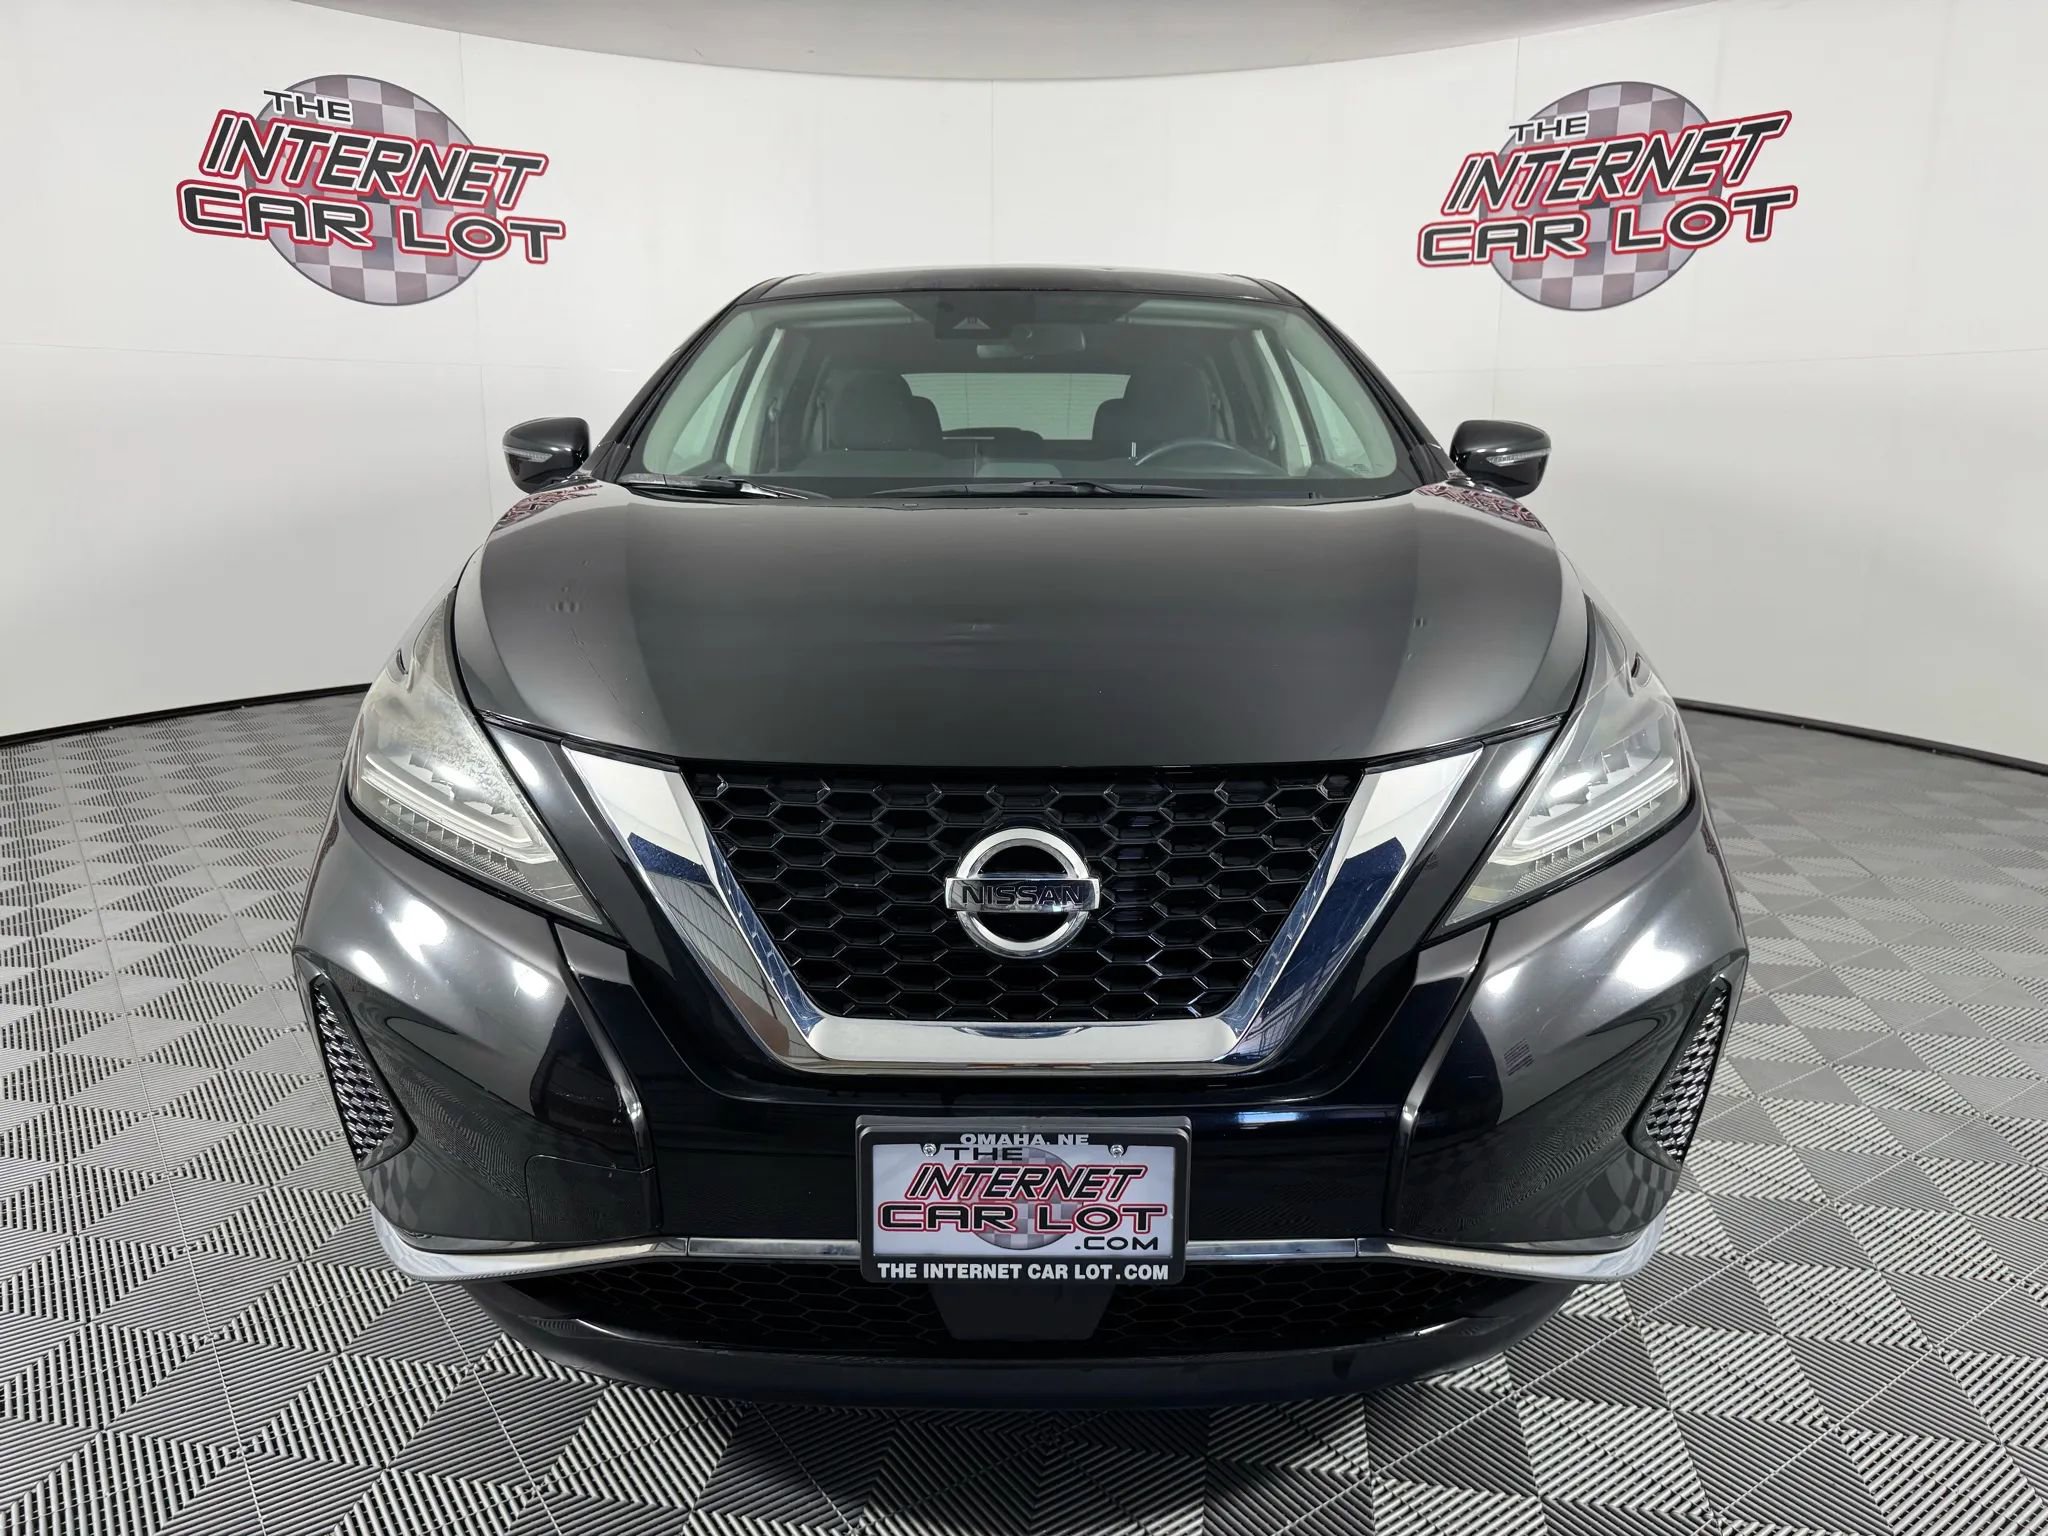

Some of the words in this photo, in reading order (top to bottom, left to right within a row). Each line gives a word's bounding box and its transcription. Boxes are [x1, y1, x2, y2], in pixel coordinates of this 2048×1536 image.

[263, 89, 353, 122] THE
[1508, 114, 1589, 143] THE
[202, 112, 546, 207] INTERNET
[1443, 112, 1790, 212] INTERNET
[179, 182, 372, 248] CAR
[399, 207, 564, 262] LOT
[1419, 214, 1589, 265] CAR
[1614, 188, 1796, 253] LOT
[962, 885, 1084, 905] NISSAN
[944, 1147, 1023, 1161] THE
[1059, 1133, 1089, 1145] NE
[905, 1163, 1147, 1200] INTERNET
[879, 1202, 1016, 1231] CAR
[1036, 1203, 1167, 1233] LOT
[1074, 1236, 1159, 1250] .COM
[877, 1263, 917, 1278] THE
[923, 1264, 1022, 1279] INTERNET
[1028, 1264, 1068, 1279] CAR
